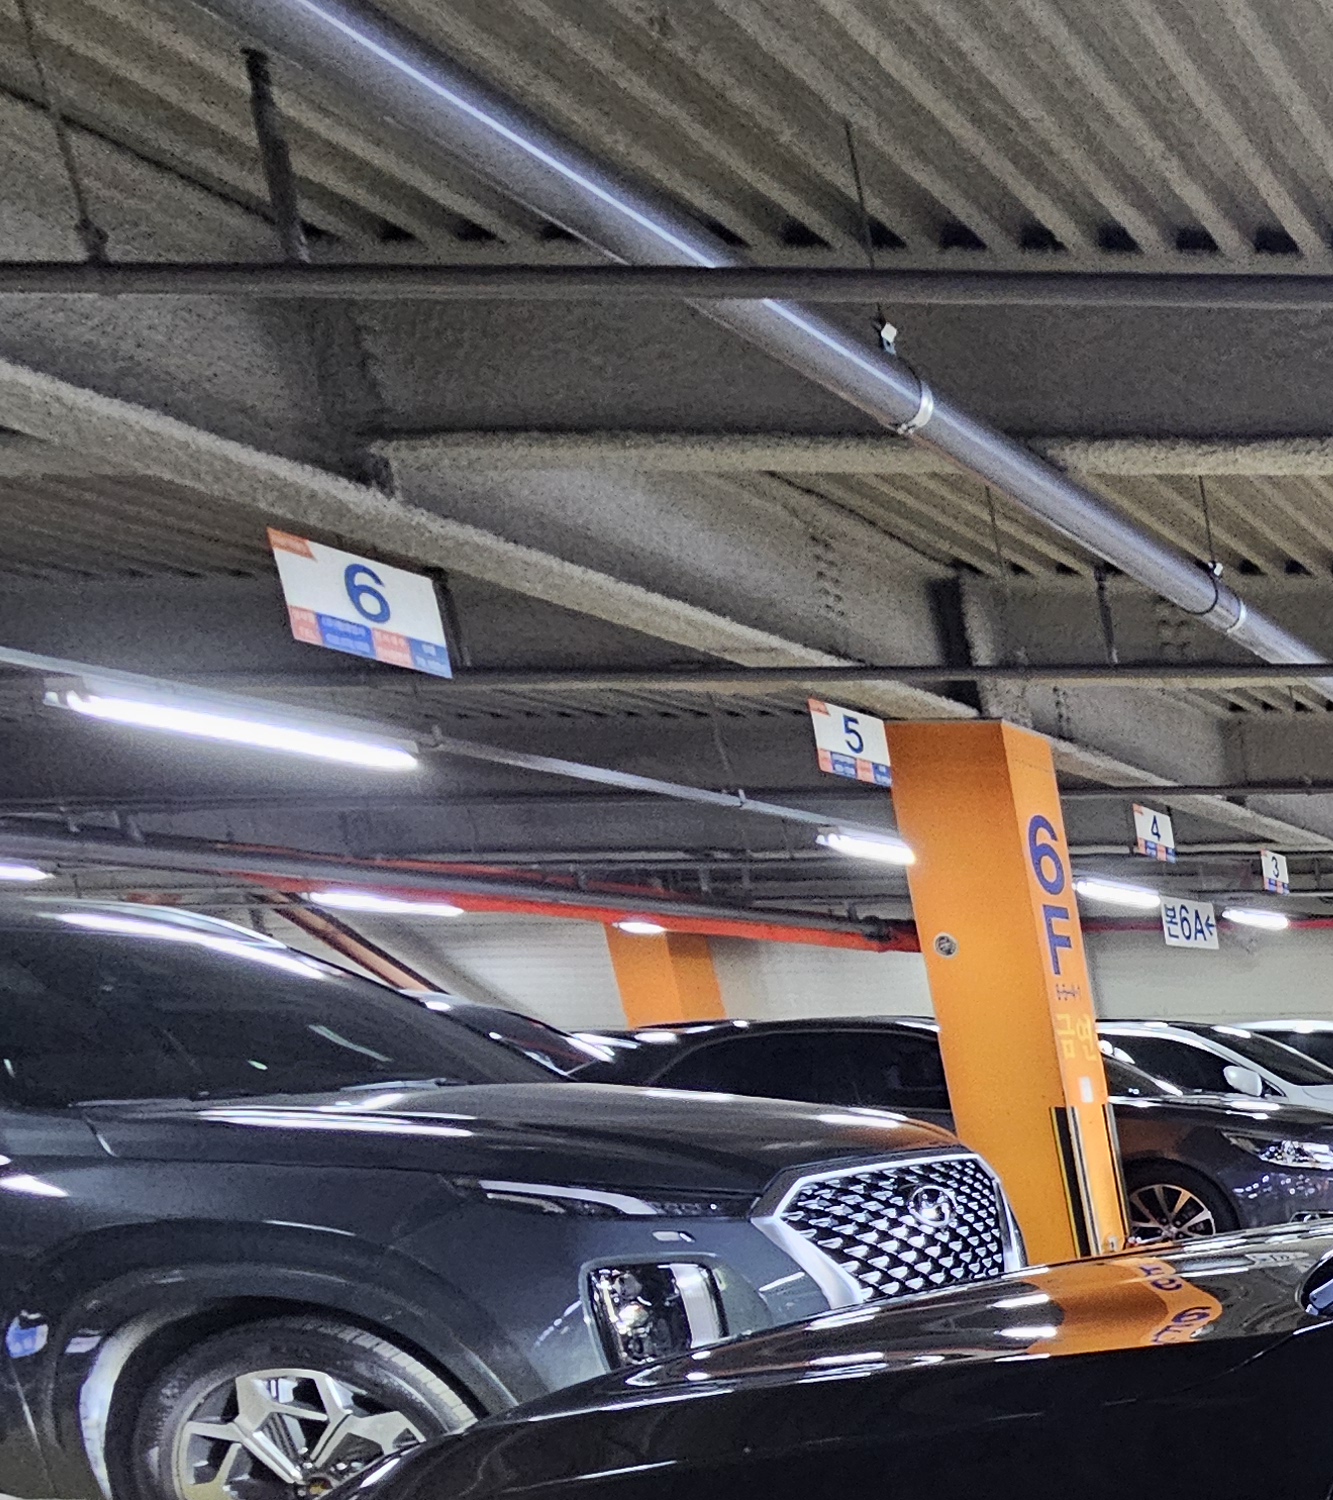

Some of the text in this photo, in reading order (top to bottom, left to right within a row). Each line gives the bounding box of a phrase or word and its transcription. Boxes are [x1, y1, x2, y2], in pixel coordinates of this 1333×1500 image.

[344, 563, 391, 623] 6
[842, 714, 865, 754] 5
[1150, 815, 1162, 841] 4
[1271, 856, 1280, 879] 3
[1164, 903, 1207, 941] 본6A
